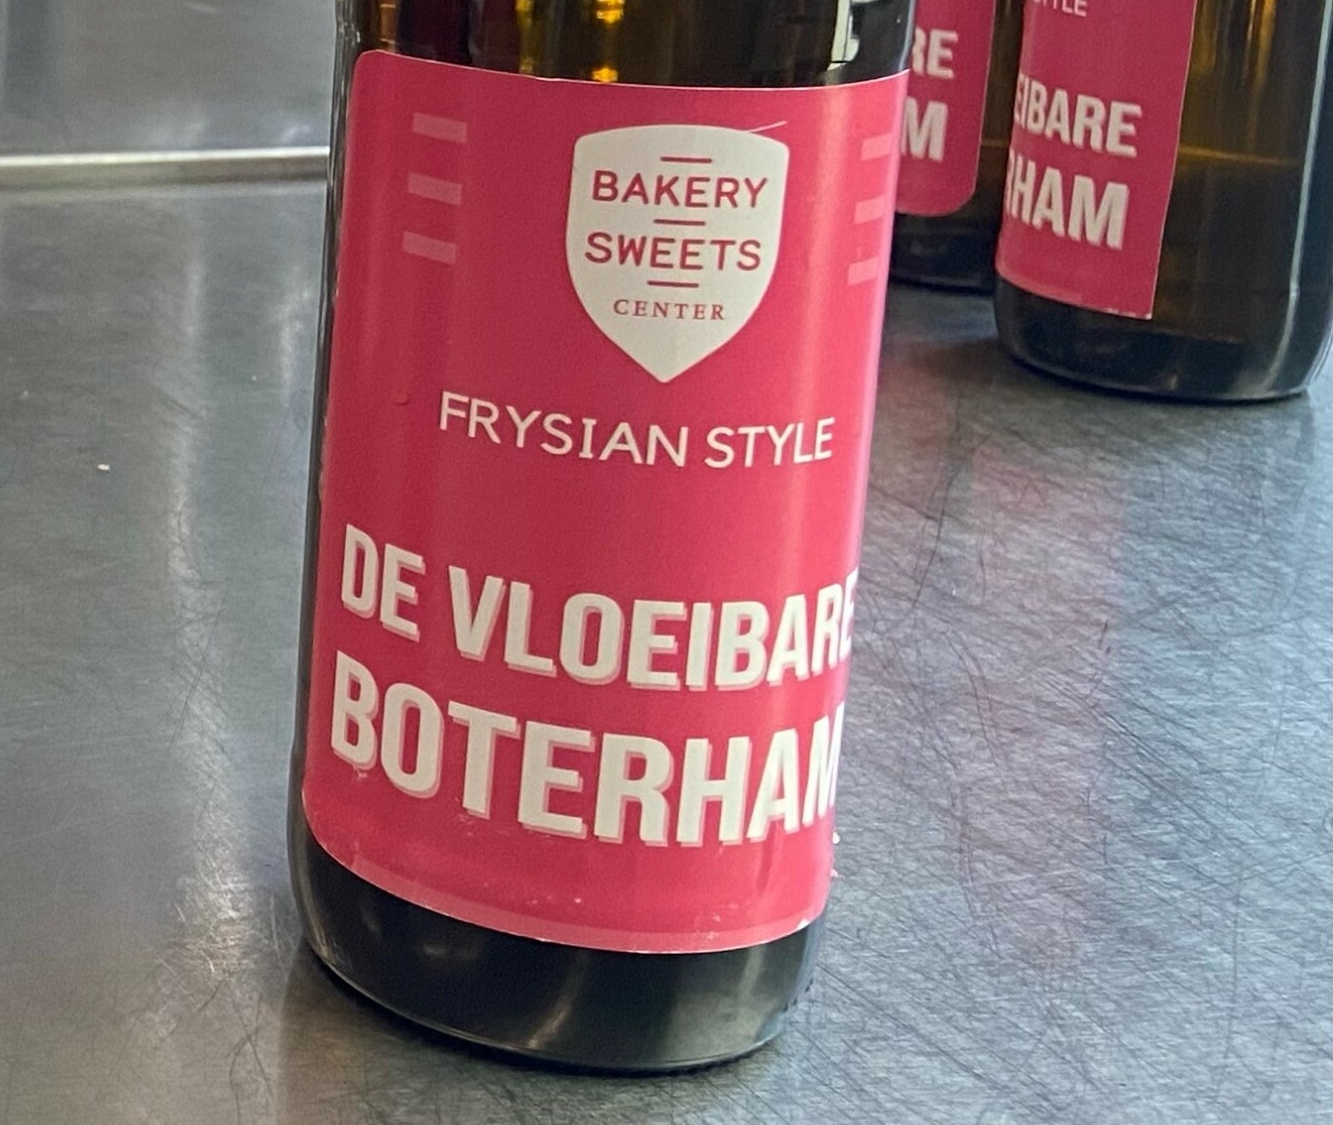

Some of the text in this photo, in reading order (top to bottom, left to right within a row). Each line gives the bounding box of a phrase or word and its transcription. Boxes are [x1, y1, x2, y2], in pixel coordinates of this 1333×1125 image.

[591, 169, 768, 209] BAKERY
[584, 231, 762, 271] SWEETS
[613, 298, 725, 320] CENTER
[439, 389, 836, 469] FRYSIAN STYLE
[340, 522, 860, 692] DE VLOEIBARE
[330, 649, 846, 848] BOTERHAM
